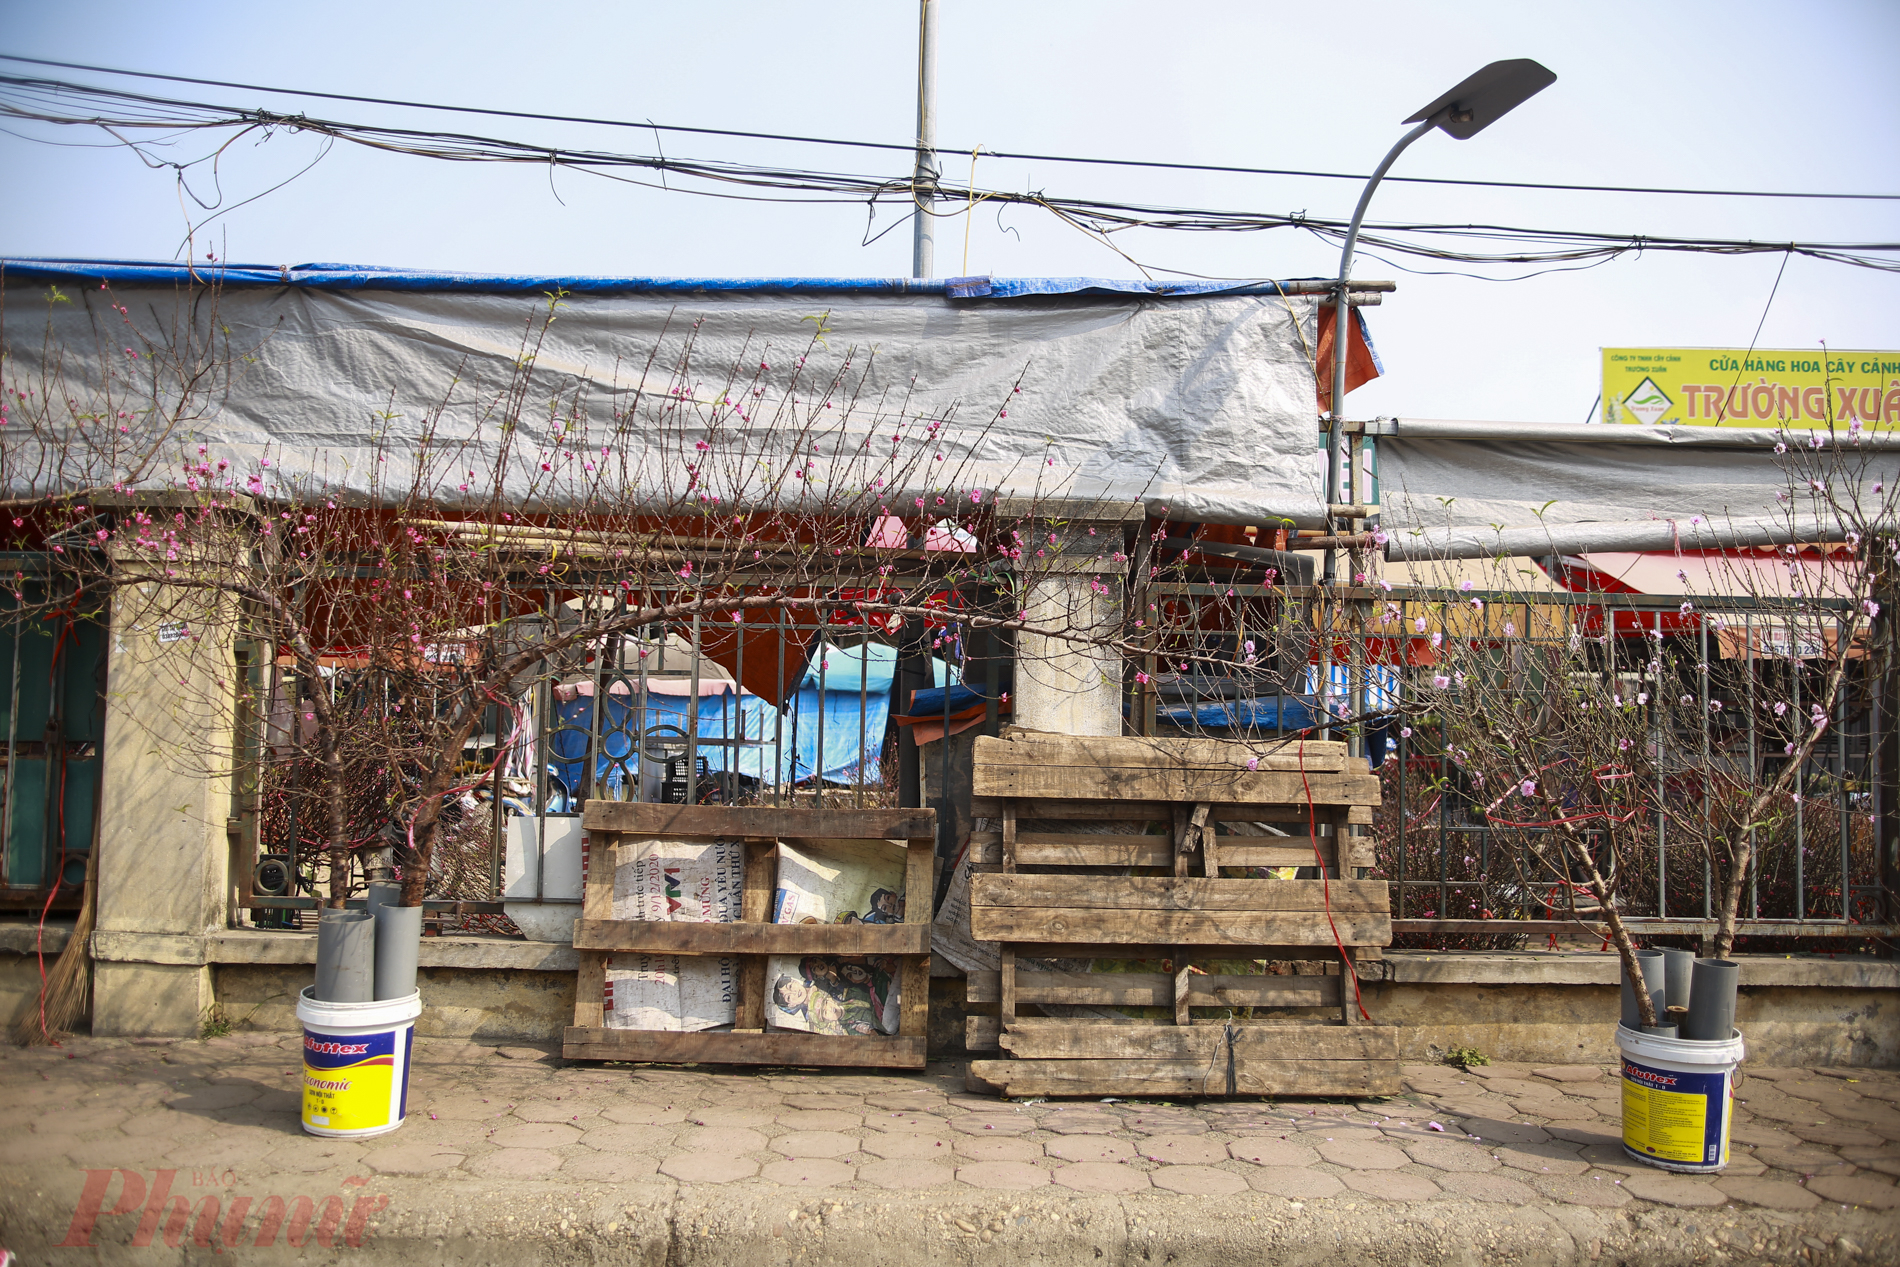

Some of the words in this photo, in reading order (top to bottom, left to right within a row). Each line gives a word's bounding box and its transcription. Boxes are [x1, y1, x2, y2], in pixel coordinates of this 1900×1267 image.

[1709, 354, 1739, 371] CỬA
[1745, 357, 1786, 373] HÀNG
[1790, 360, 1821, 373] HOA
[1827, 358, 1856, 373] CÂY
[1681, 377, 1825, 423] TRƯỜNG
[714, 836, 727, 864] NƯỚ
[731, 839, 740, 848] X
[631, 860, 646, 882] tiếp
[728, 851, 740, 877] THỨ
[649, 853, 662, 912] 9/12/2020
[664, 868, 682, 915] VTV1
[715, 867, 728, 893] YÊU
[635, 884, 646, 909] trực
[699, 876, 712, 917] MỪNG
[728, 881, 742, 907] LẦN
[721, 980, 733, 1003] ĐẠI
[304, 1070, 353, 1091] Economic
[323, 1091, 335, 1099] THẤT
